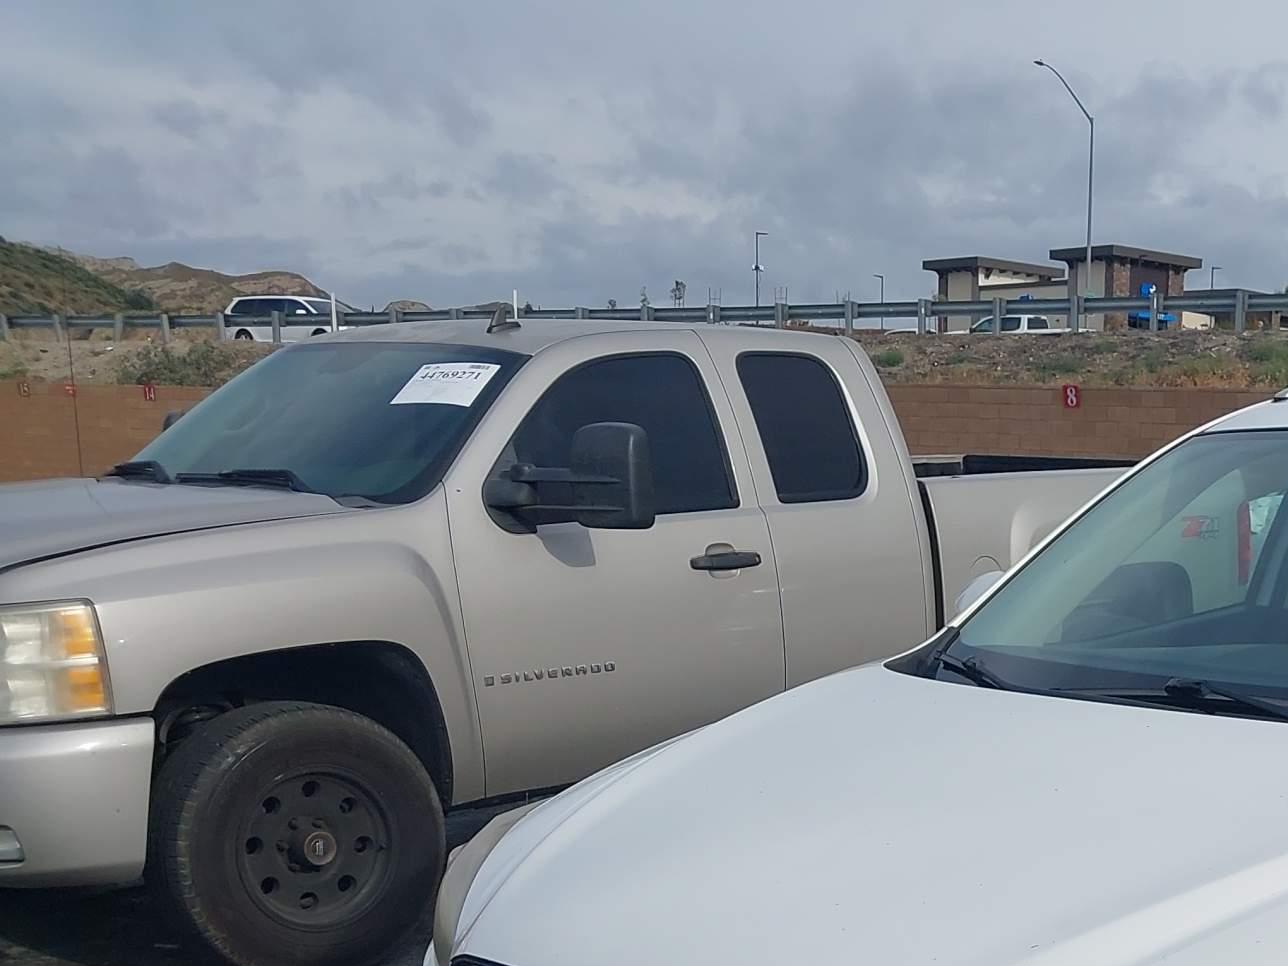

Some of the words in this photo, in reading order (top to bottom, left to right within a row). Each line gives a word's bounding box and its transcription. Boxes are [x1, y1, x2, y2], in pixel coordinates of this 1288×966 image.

[420, 370, 482, 380] 44769271
[1066, 386, 1077, 407] 8
[500, 660, 616, 685] SILVERADO
